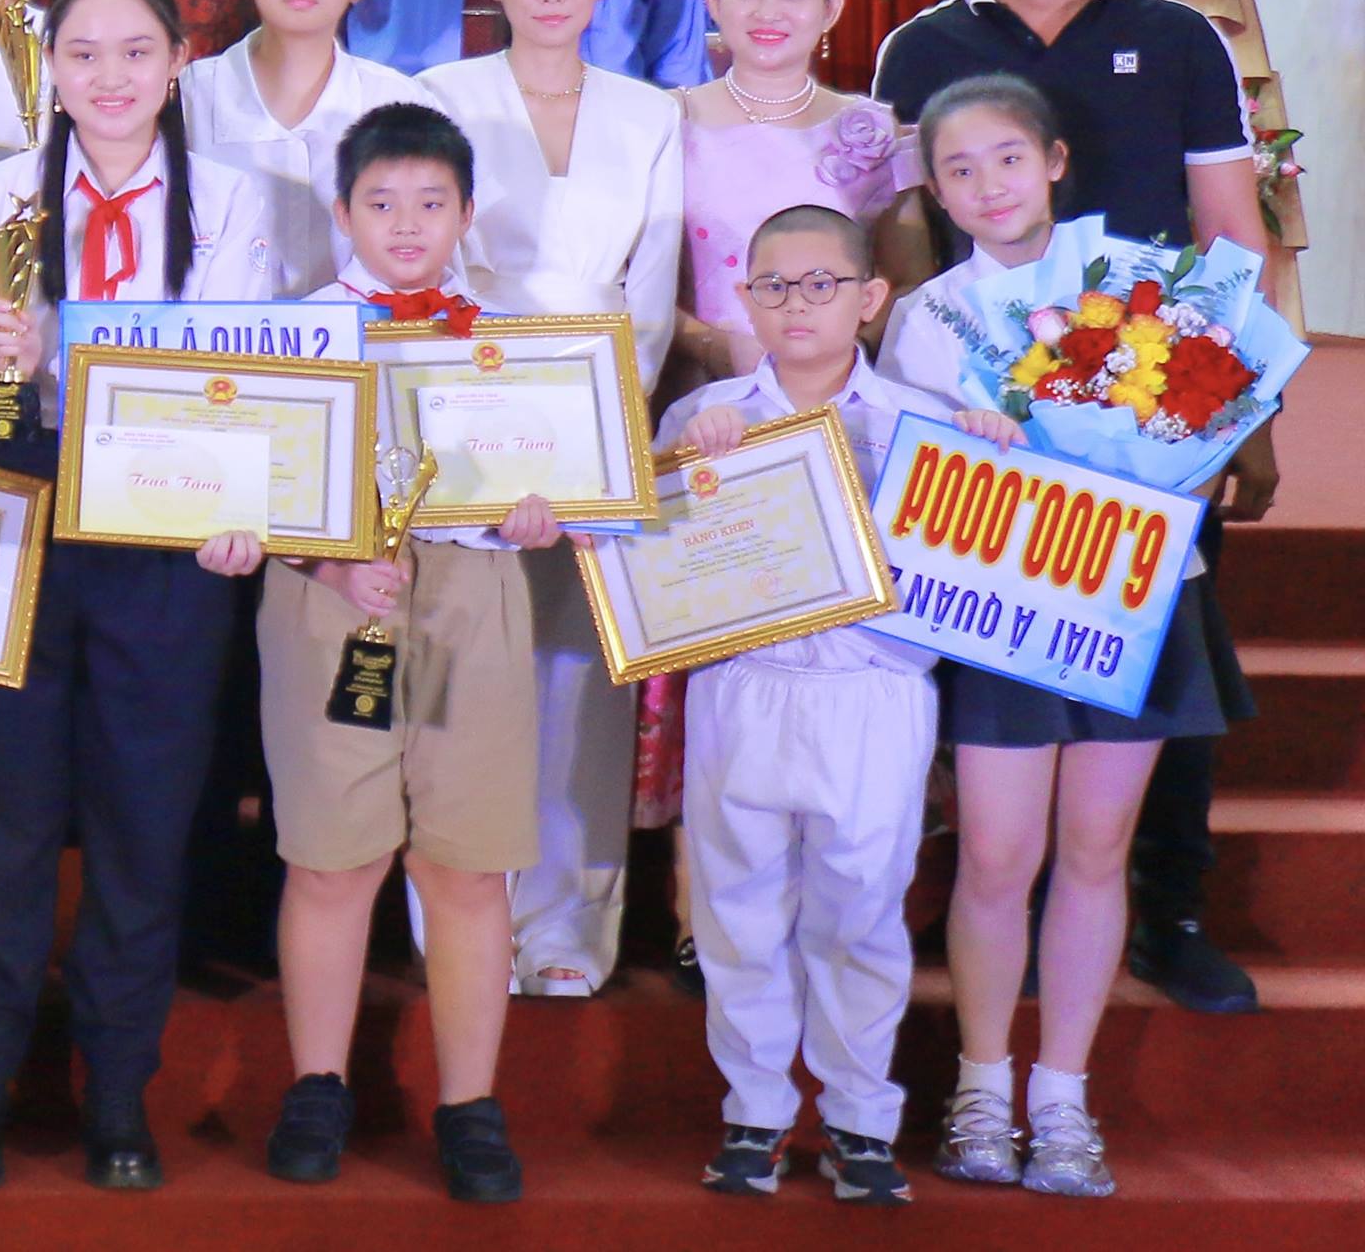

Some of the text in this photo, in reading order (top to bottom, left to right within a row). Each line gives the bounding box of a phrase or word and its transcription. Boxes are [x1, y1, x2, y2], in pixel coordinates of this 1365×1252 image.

[312, 327, 331, 359] 2
[467, 438, 504, 452] Trao
[129, 472, 169, 487] Trao
[720, 519, 756, 538] KHEN
[892, 441, 1168, 612] 6.000.000đ
[903, 574, 1126, 681] GIẢI Á QUÂN
